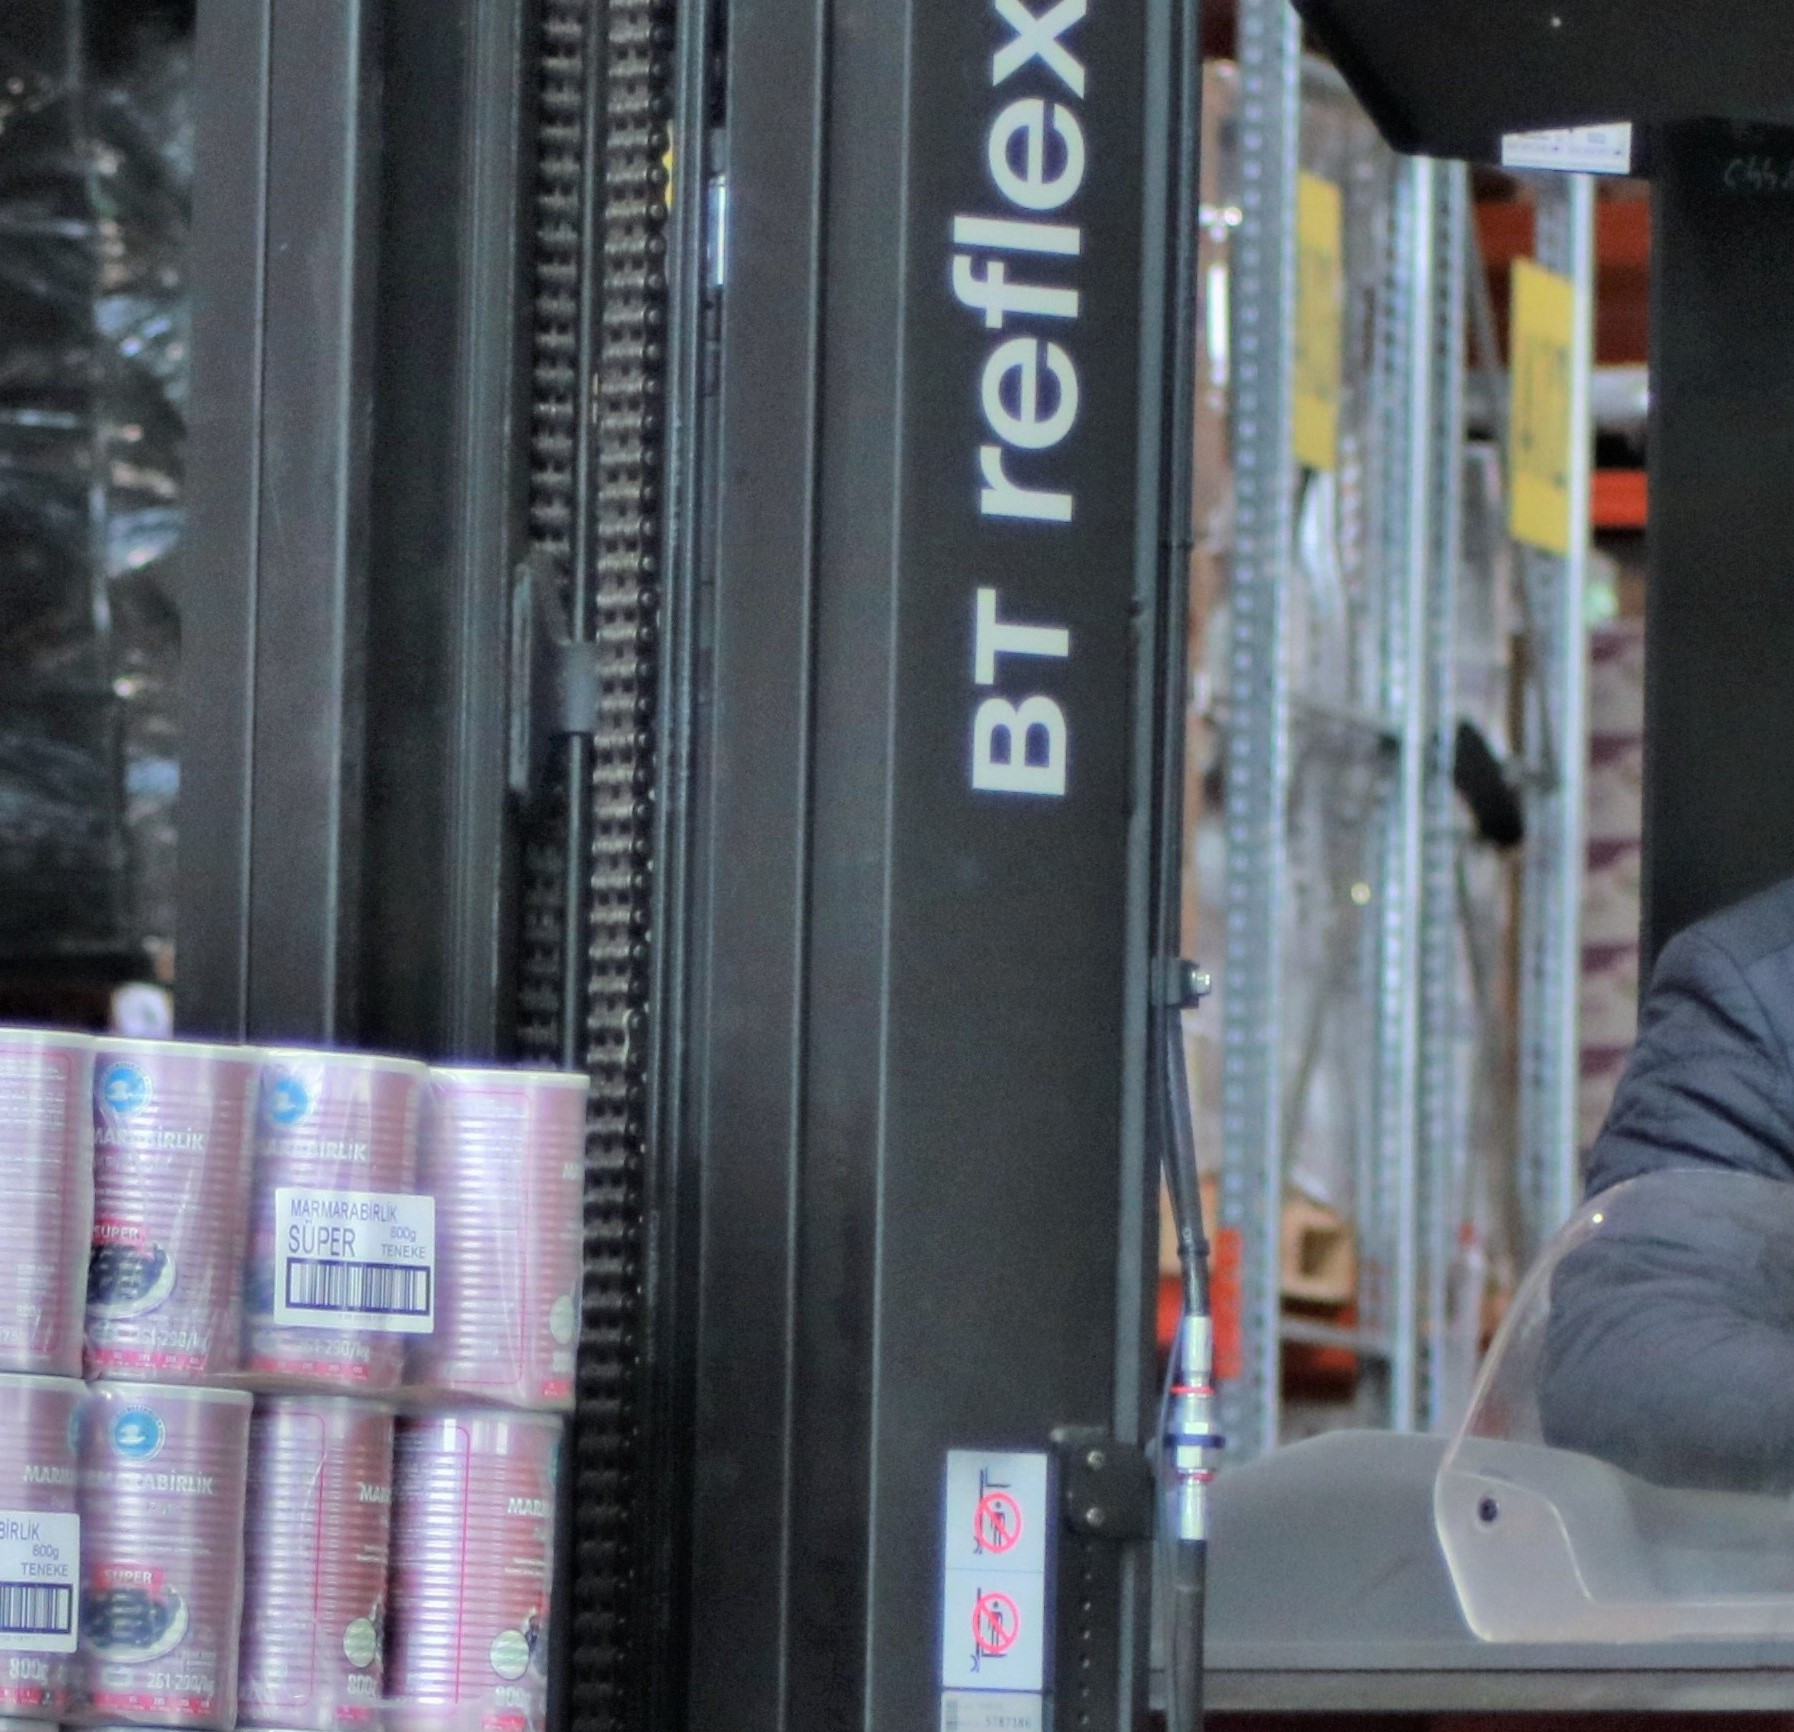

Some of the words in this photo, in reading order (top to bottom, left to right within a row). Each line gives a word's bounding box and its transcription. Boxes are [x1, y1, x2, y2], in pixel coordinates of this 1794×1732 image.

[952, 0, 1088, 523] reflex
[970, 587, 1070, 797] BT
[291, 1199, 398, 1221] MARMARABİRLİK
[288, 1219, 356, 1257] SÜPER
[390, 1227, 418, 1242] 800g
[381, 1243, 427, 1259] TENEKE
[32, 1544, 60, 1560] 800g
[21, 1562, 69, 1577] TENEKE
